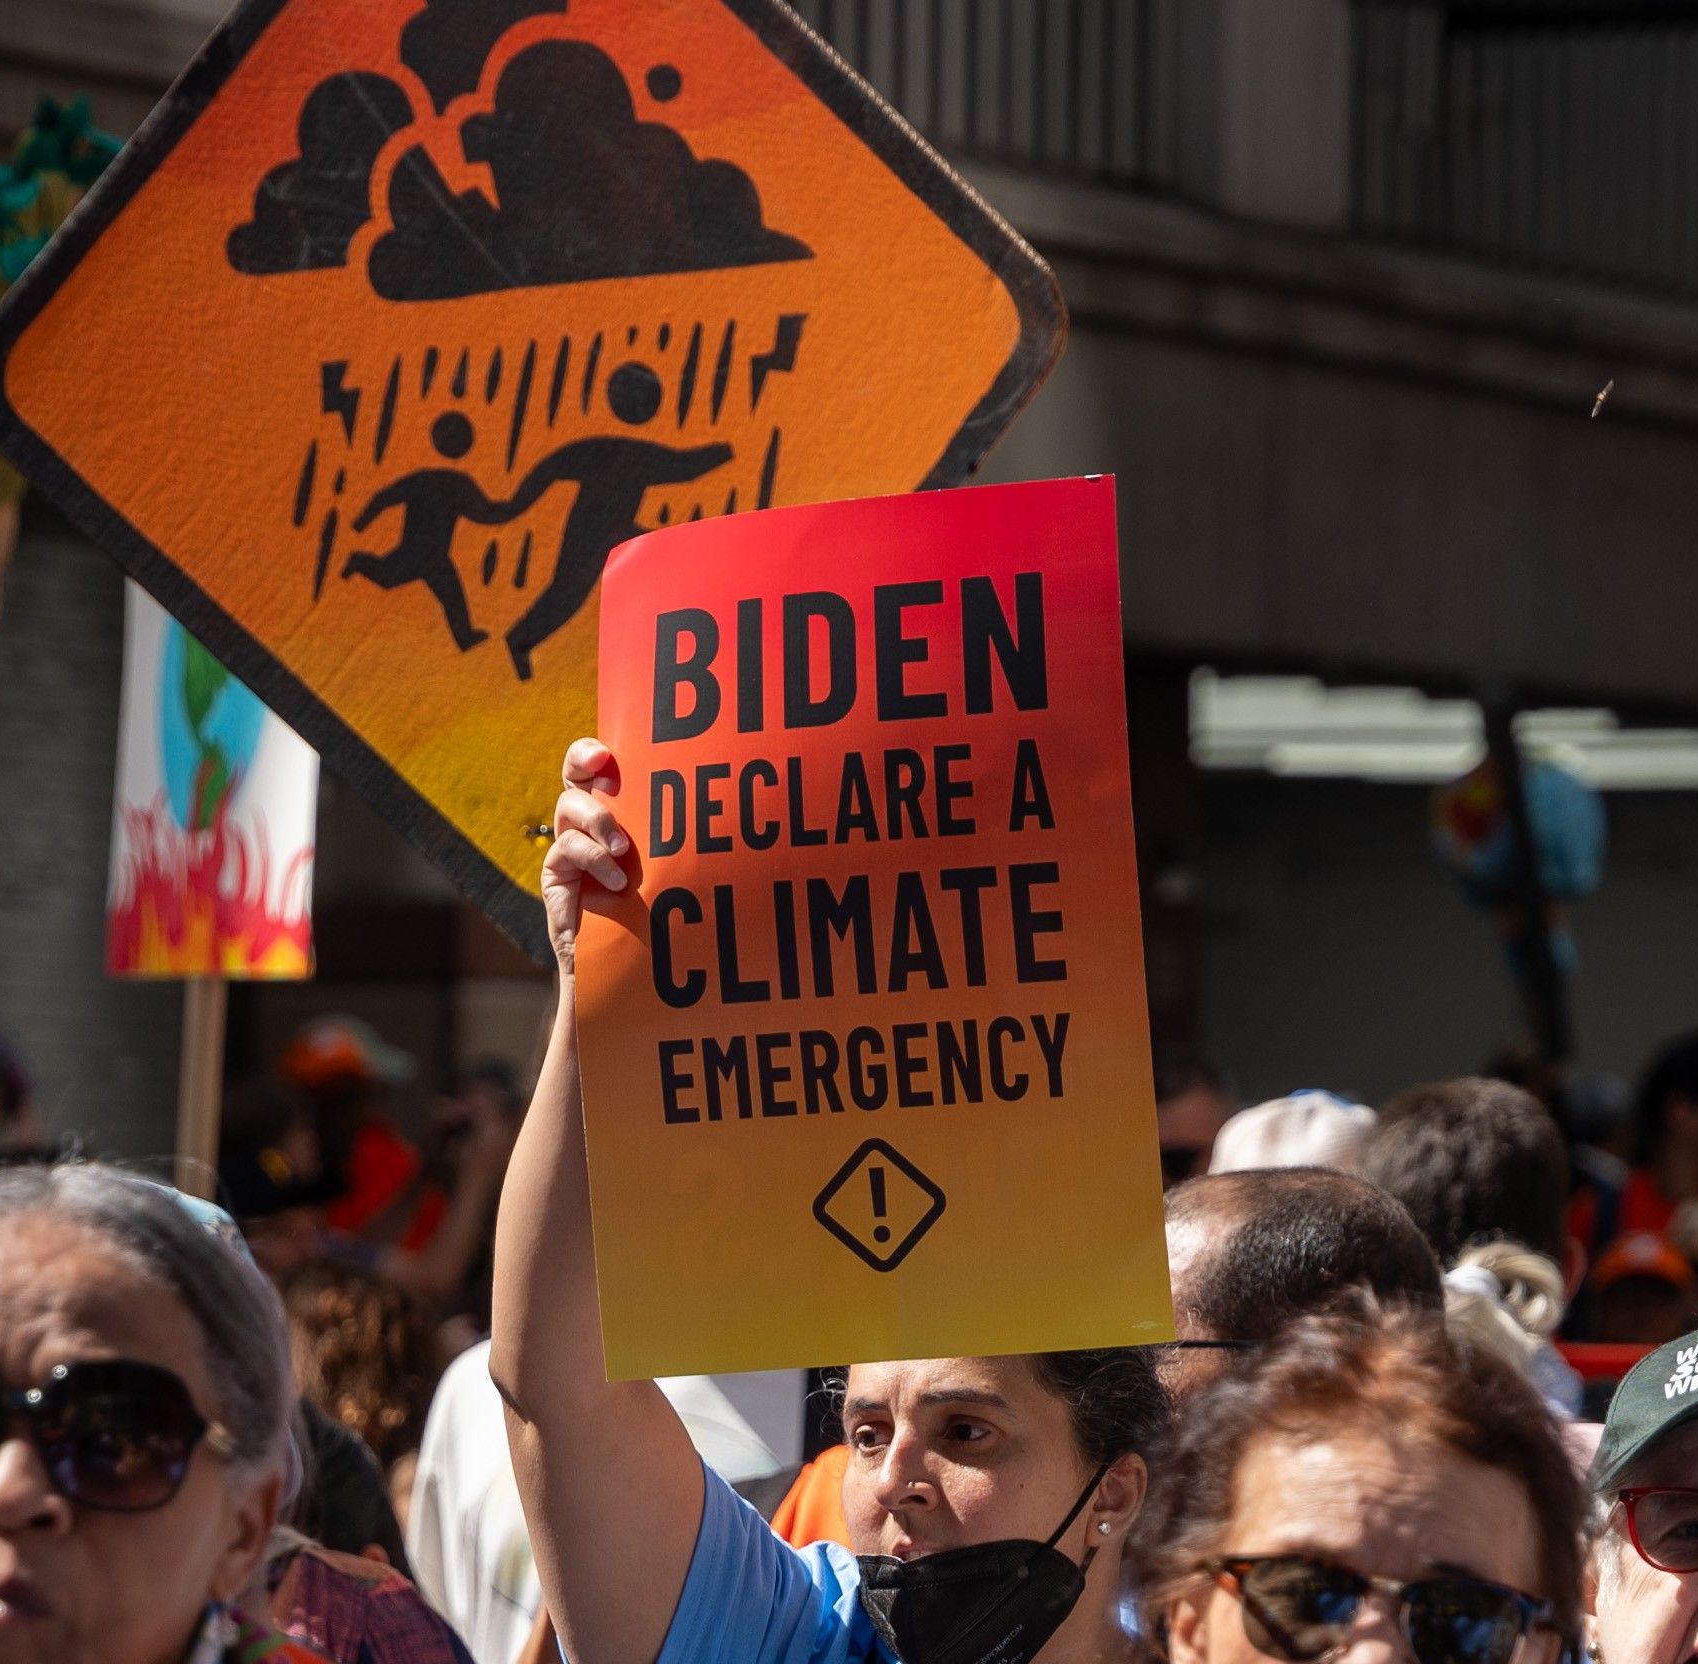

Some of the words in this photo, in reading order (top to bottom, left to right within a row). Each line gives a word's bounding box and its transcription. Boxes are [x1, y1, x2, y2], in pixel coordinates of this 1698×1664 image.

[651, 571, 1049, 744] BIDEN
[649, 742, 976, 858] DECLARE
[1009, 738, 1056, 832] A
[649, 862, 1068, 1008] CLIMATE
[658, 1012, 1071, 1126] EMERGENCY
